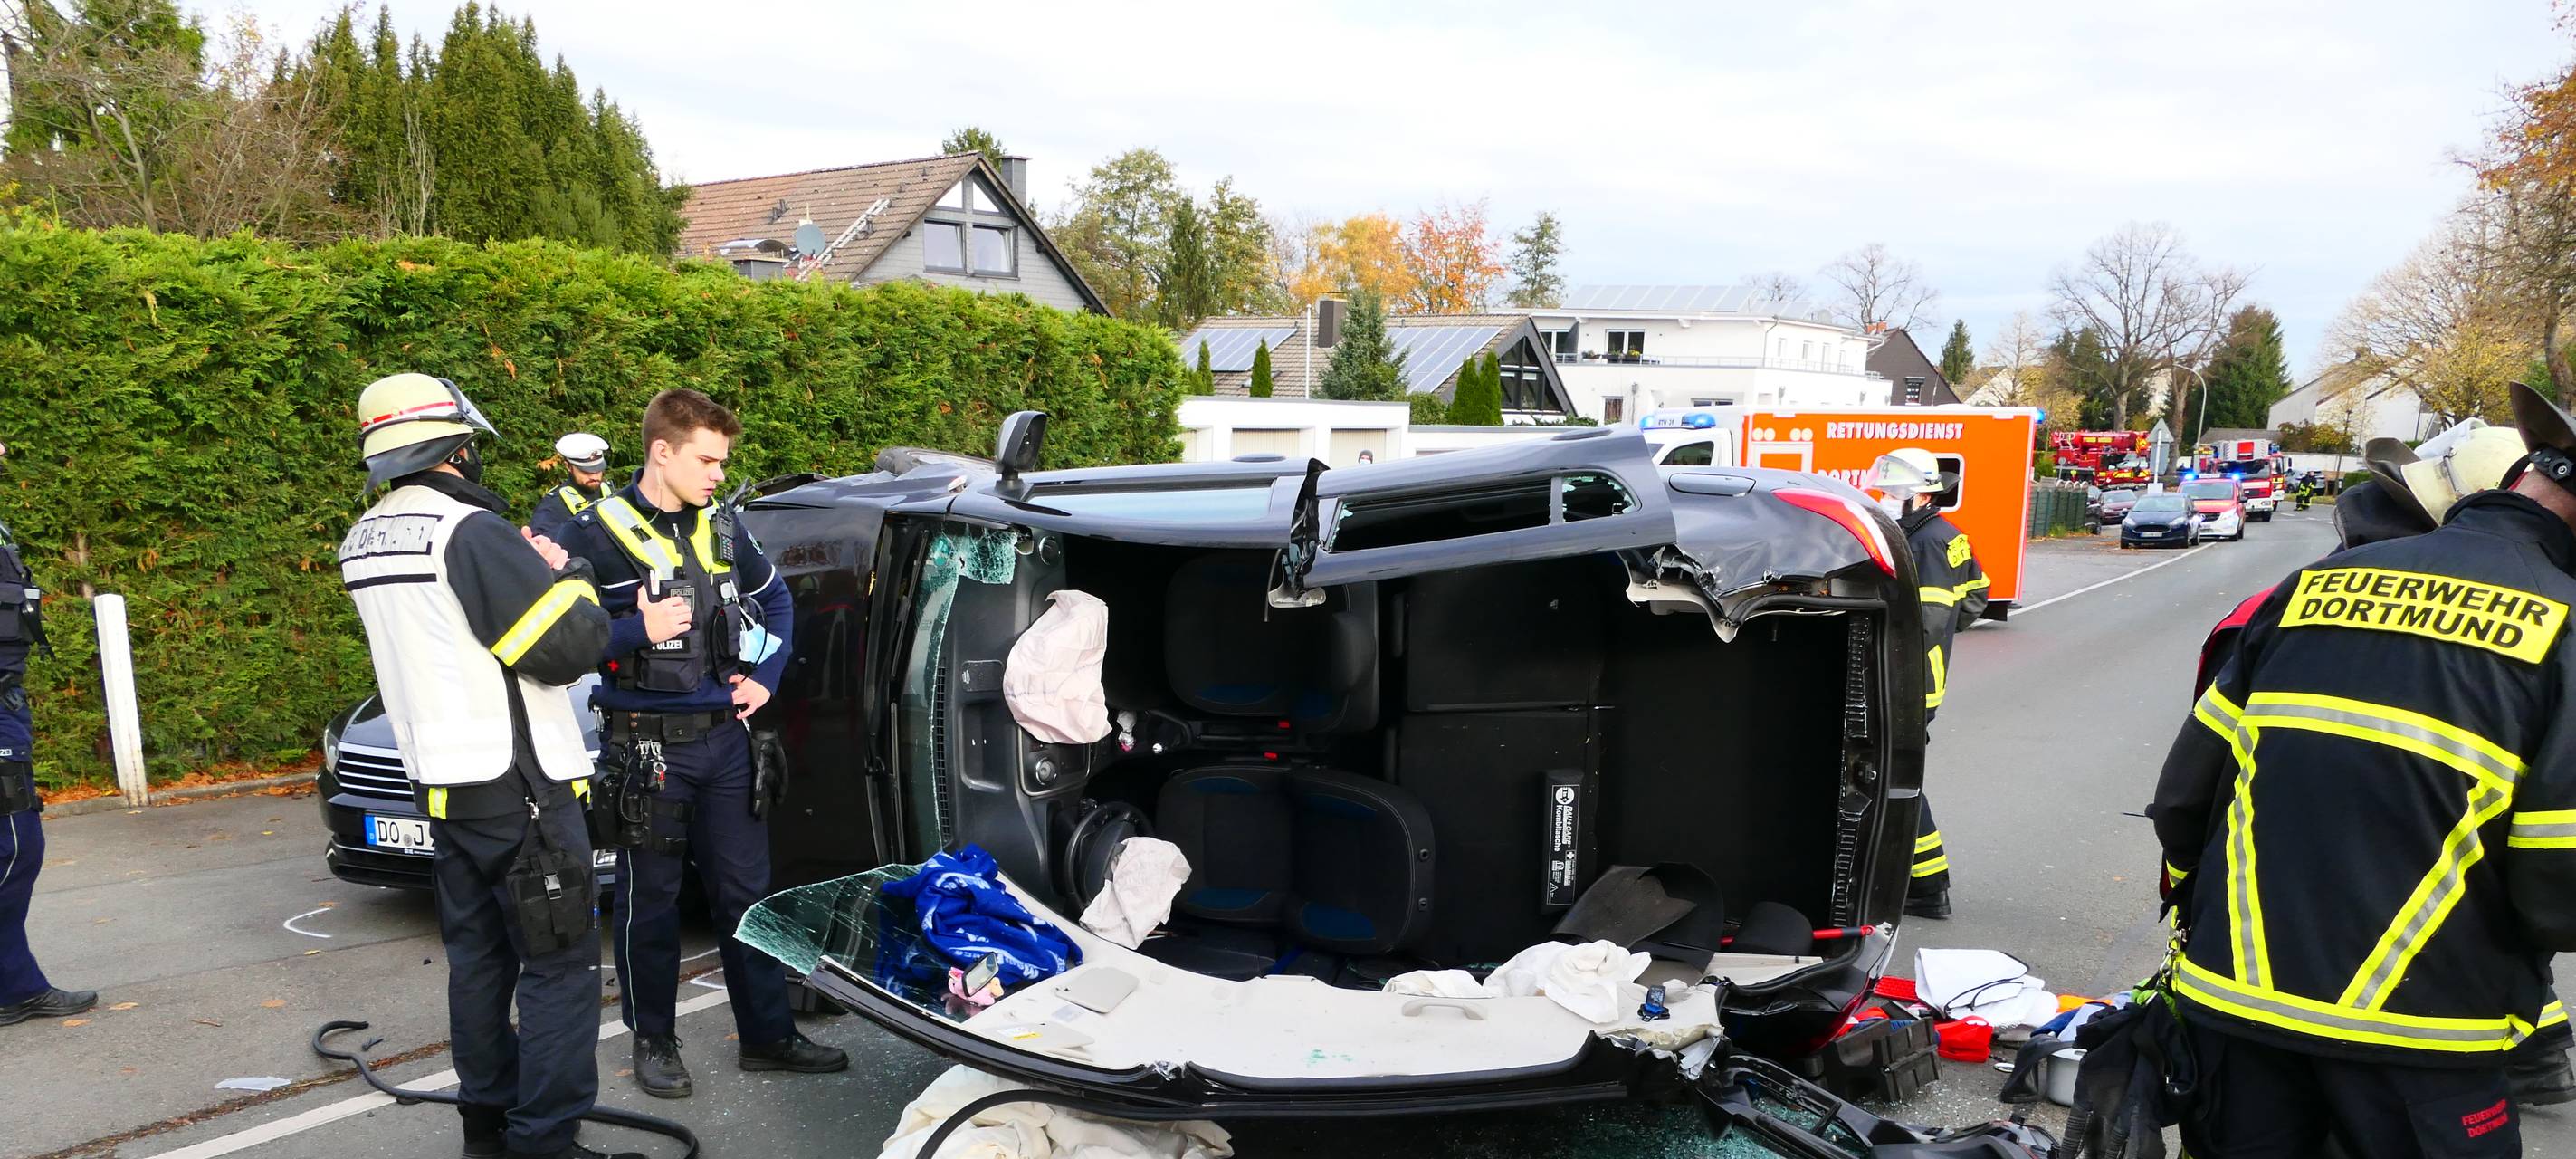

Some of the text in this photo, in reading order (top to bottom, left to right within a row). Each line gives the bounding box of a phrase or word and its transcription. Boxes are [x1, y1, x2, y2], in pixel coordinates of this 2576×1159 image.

[1826, 422, 1964, 440] RETTUNGSDIENST
[2298, 597, 2524, 649] DORTMUND
[2303, 572, 2549, 627] FEUERWEHR
[377, 820, 424, 845] DO J
[1553, 805, 1563, 852] Kombitasche
